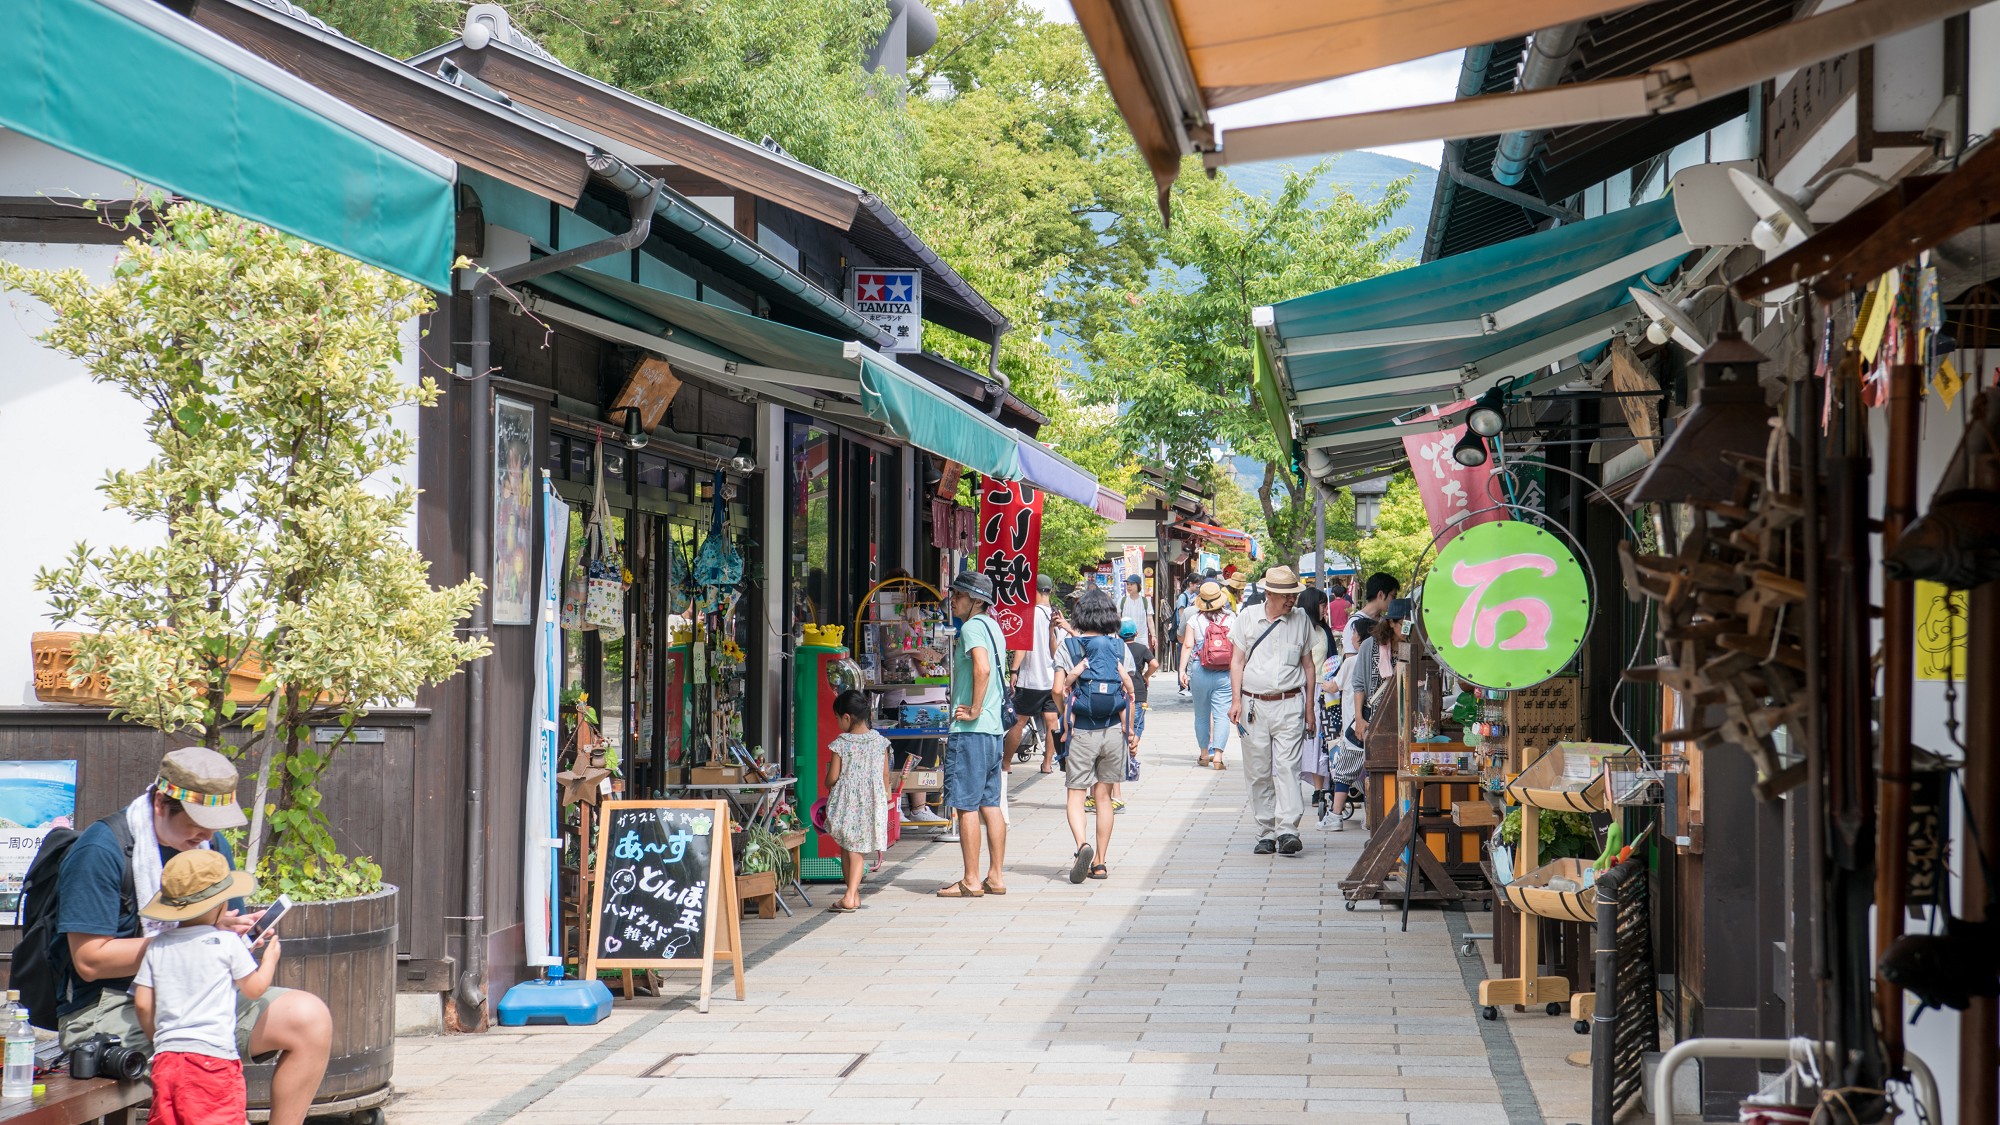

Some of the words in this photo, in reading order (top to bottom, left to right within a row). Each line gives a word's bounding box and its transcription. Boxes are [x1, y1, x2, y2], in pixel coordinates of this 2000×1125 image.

[858, 302, 912, 314] TAMIYA
[1450, 553, 1557, 652] 石
[603, 903, 672, 941] ハンドメイド
[623, 925, 656, 951] 雑貨
